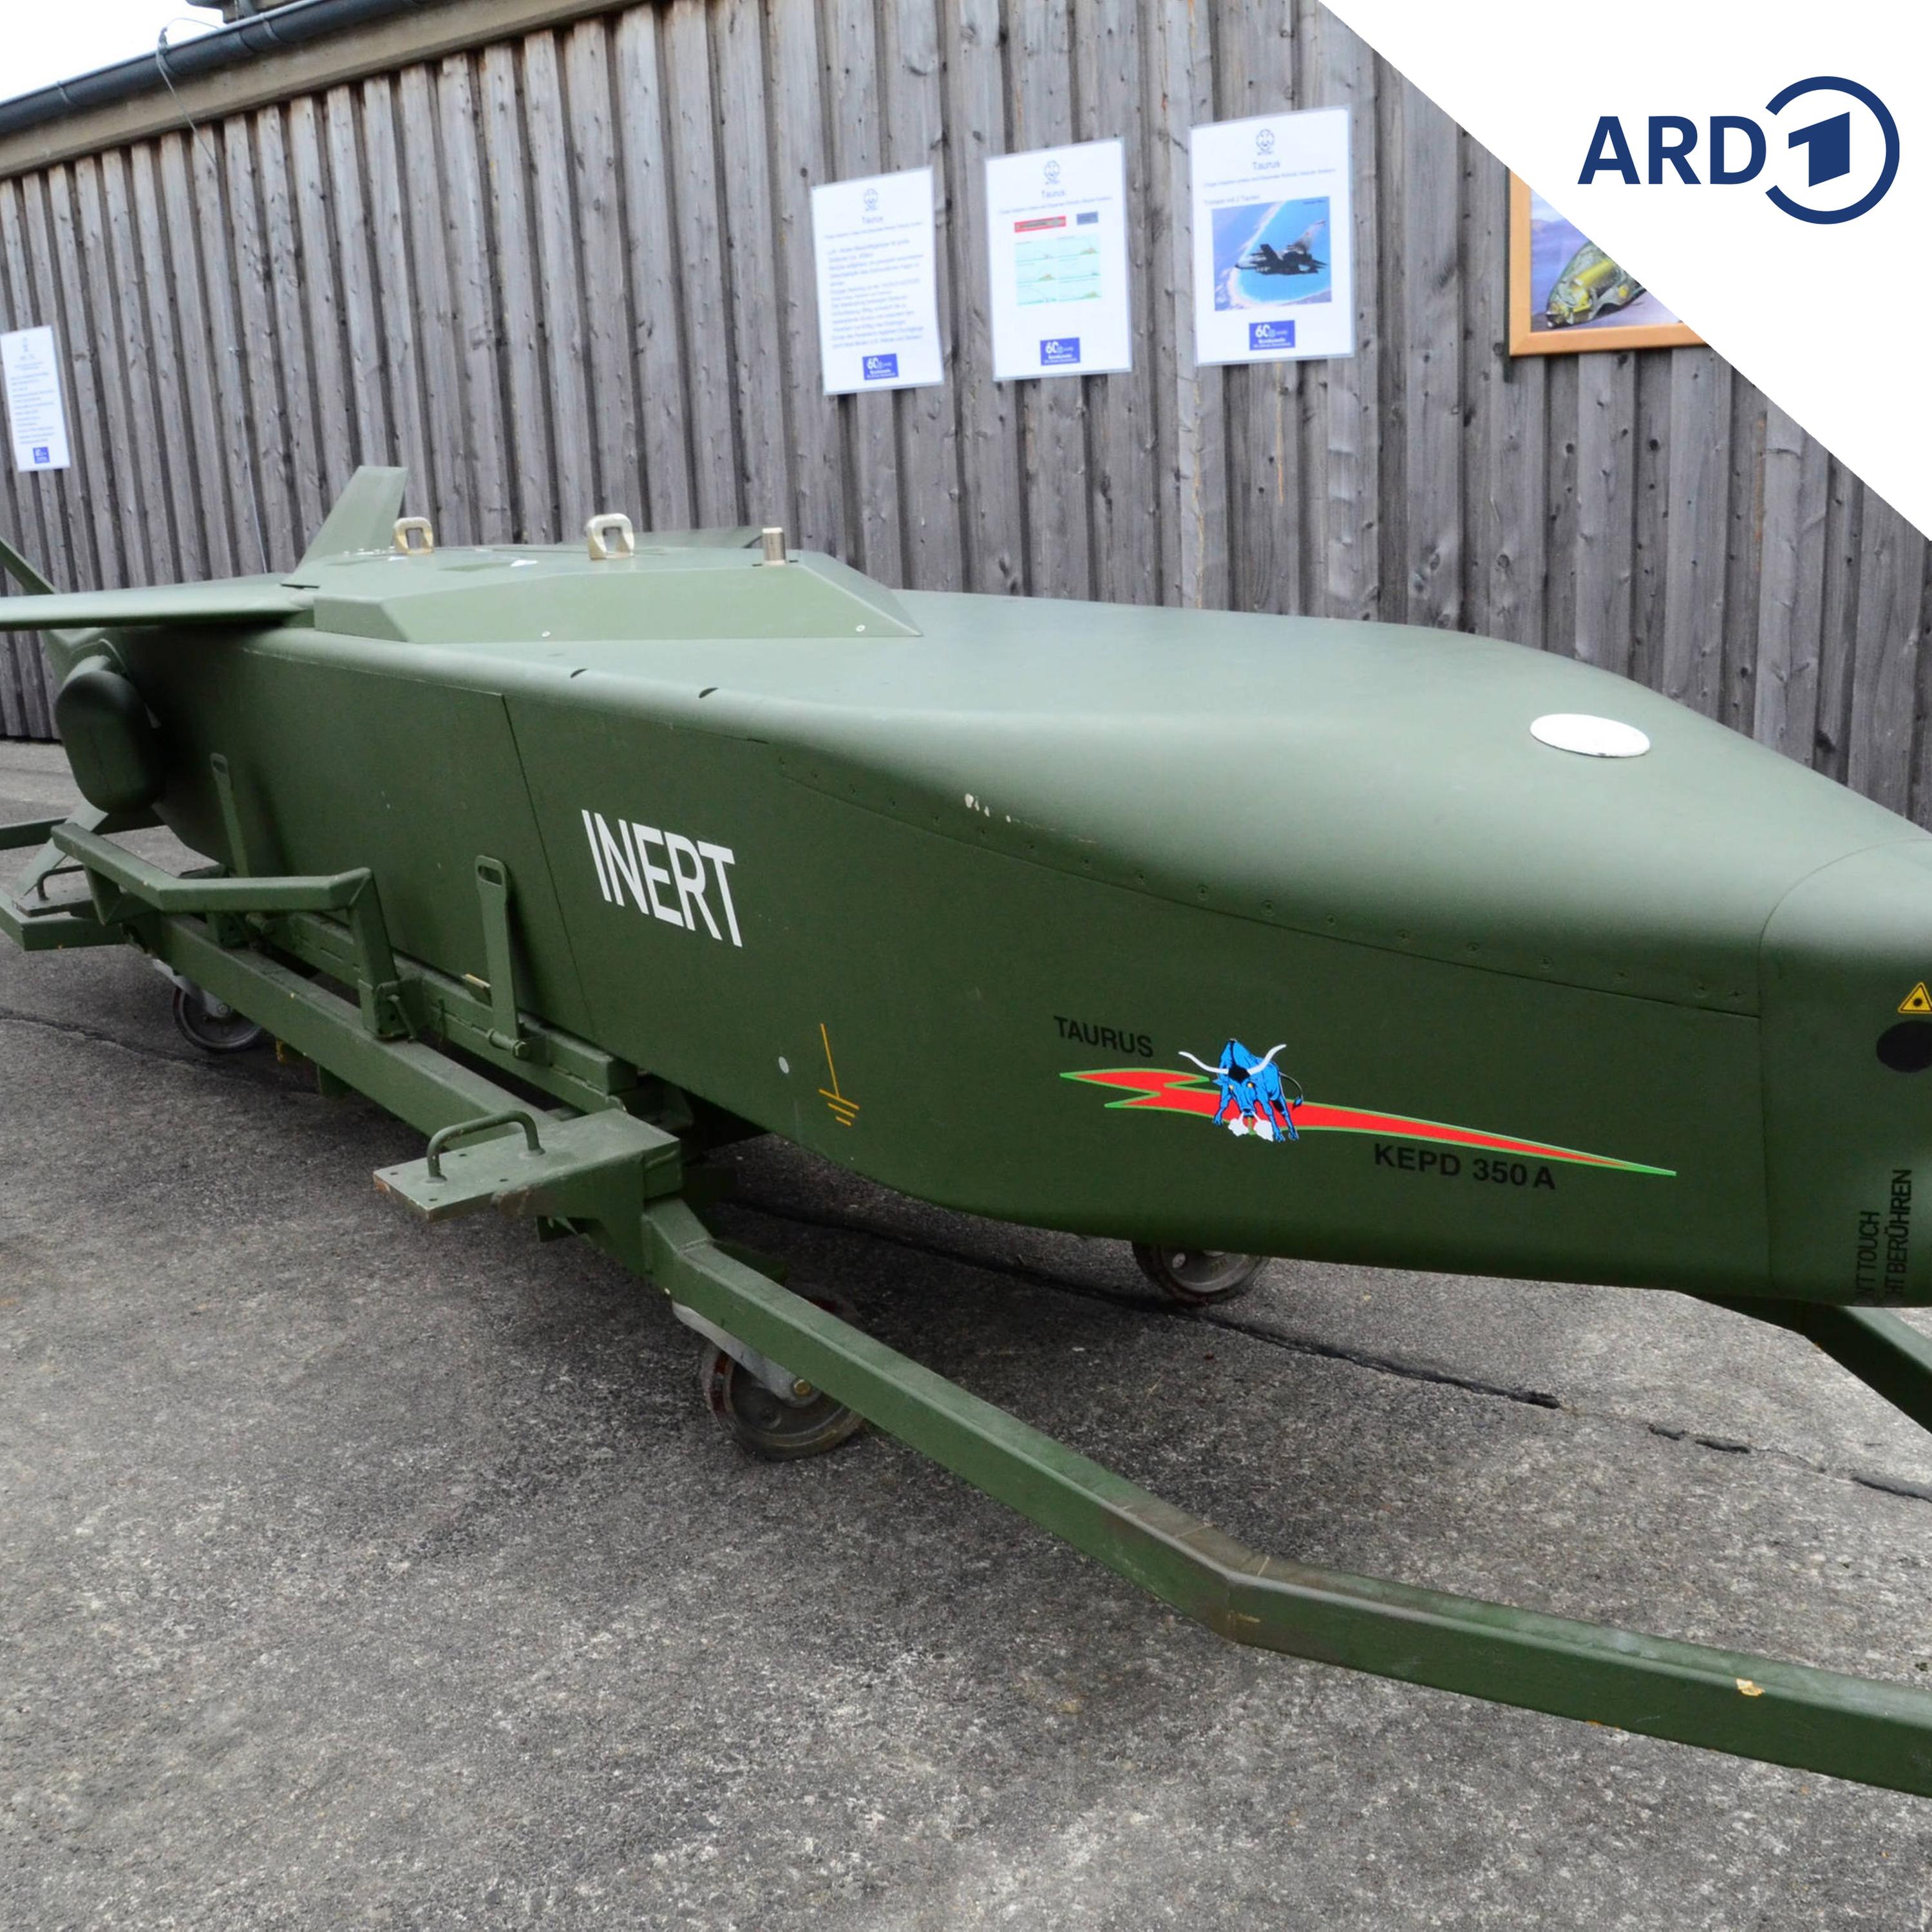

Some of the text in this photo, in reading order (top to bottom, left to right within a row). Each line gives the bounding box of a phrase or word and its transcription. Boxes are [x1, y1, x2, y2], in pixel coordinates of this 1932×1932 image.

[582, 809, 743, 947] INERT
[1054, 1016, 1153, 1057] TAURUS
[1374, 1143, 1461, 1177] KEPD
[1857, 1210, 1880, 1272] TOUCH
[1883, 1170, 1913, 1274] BERÜHREN
